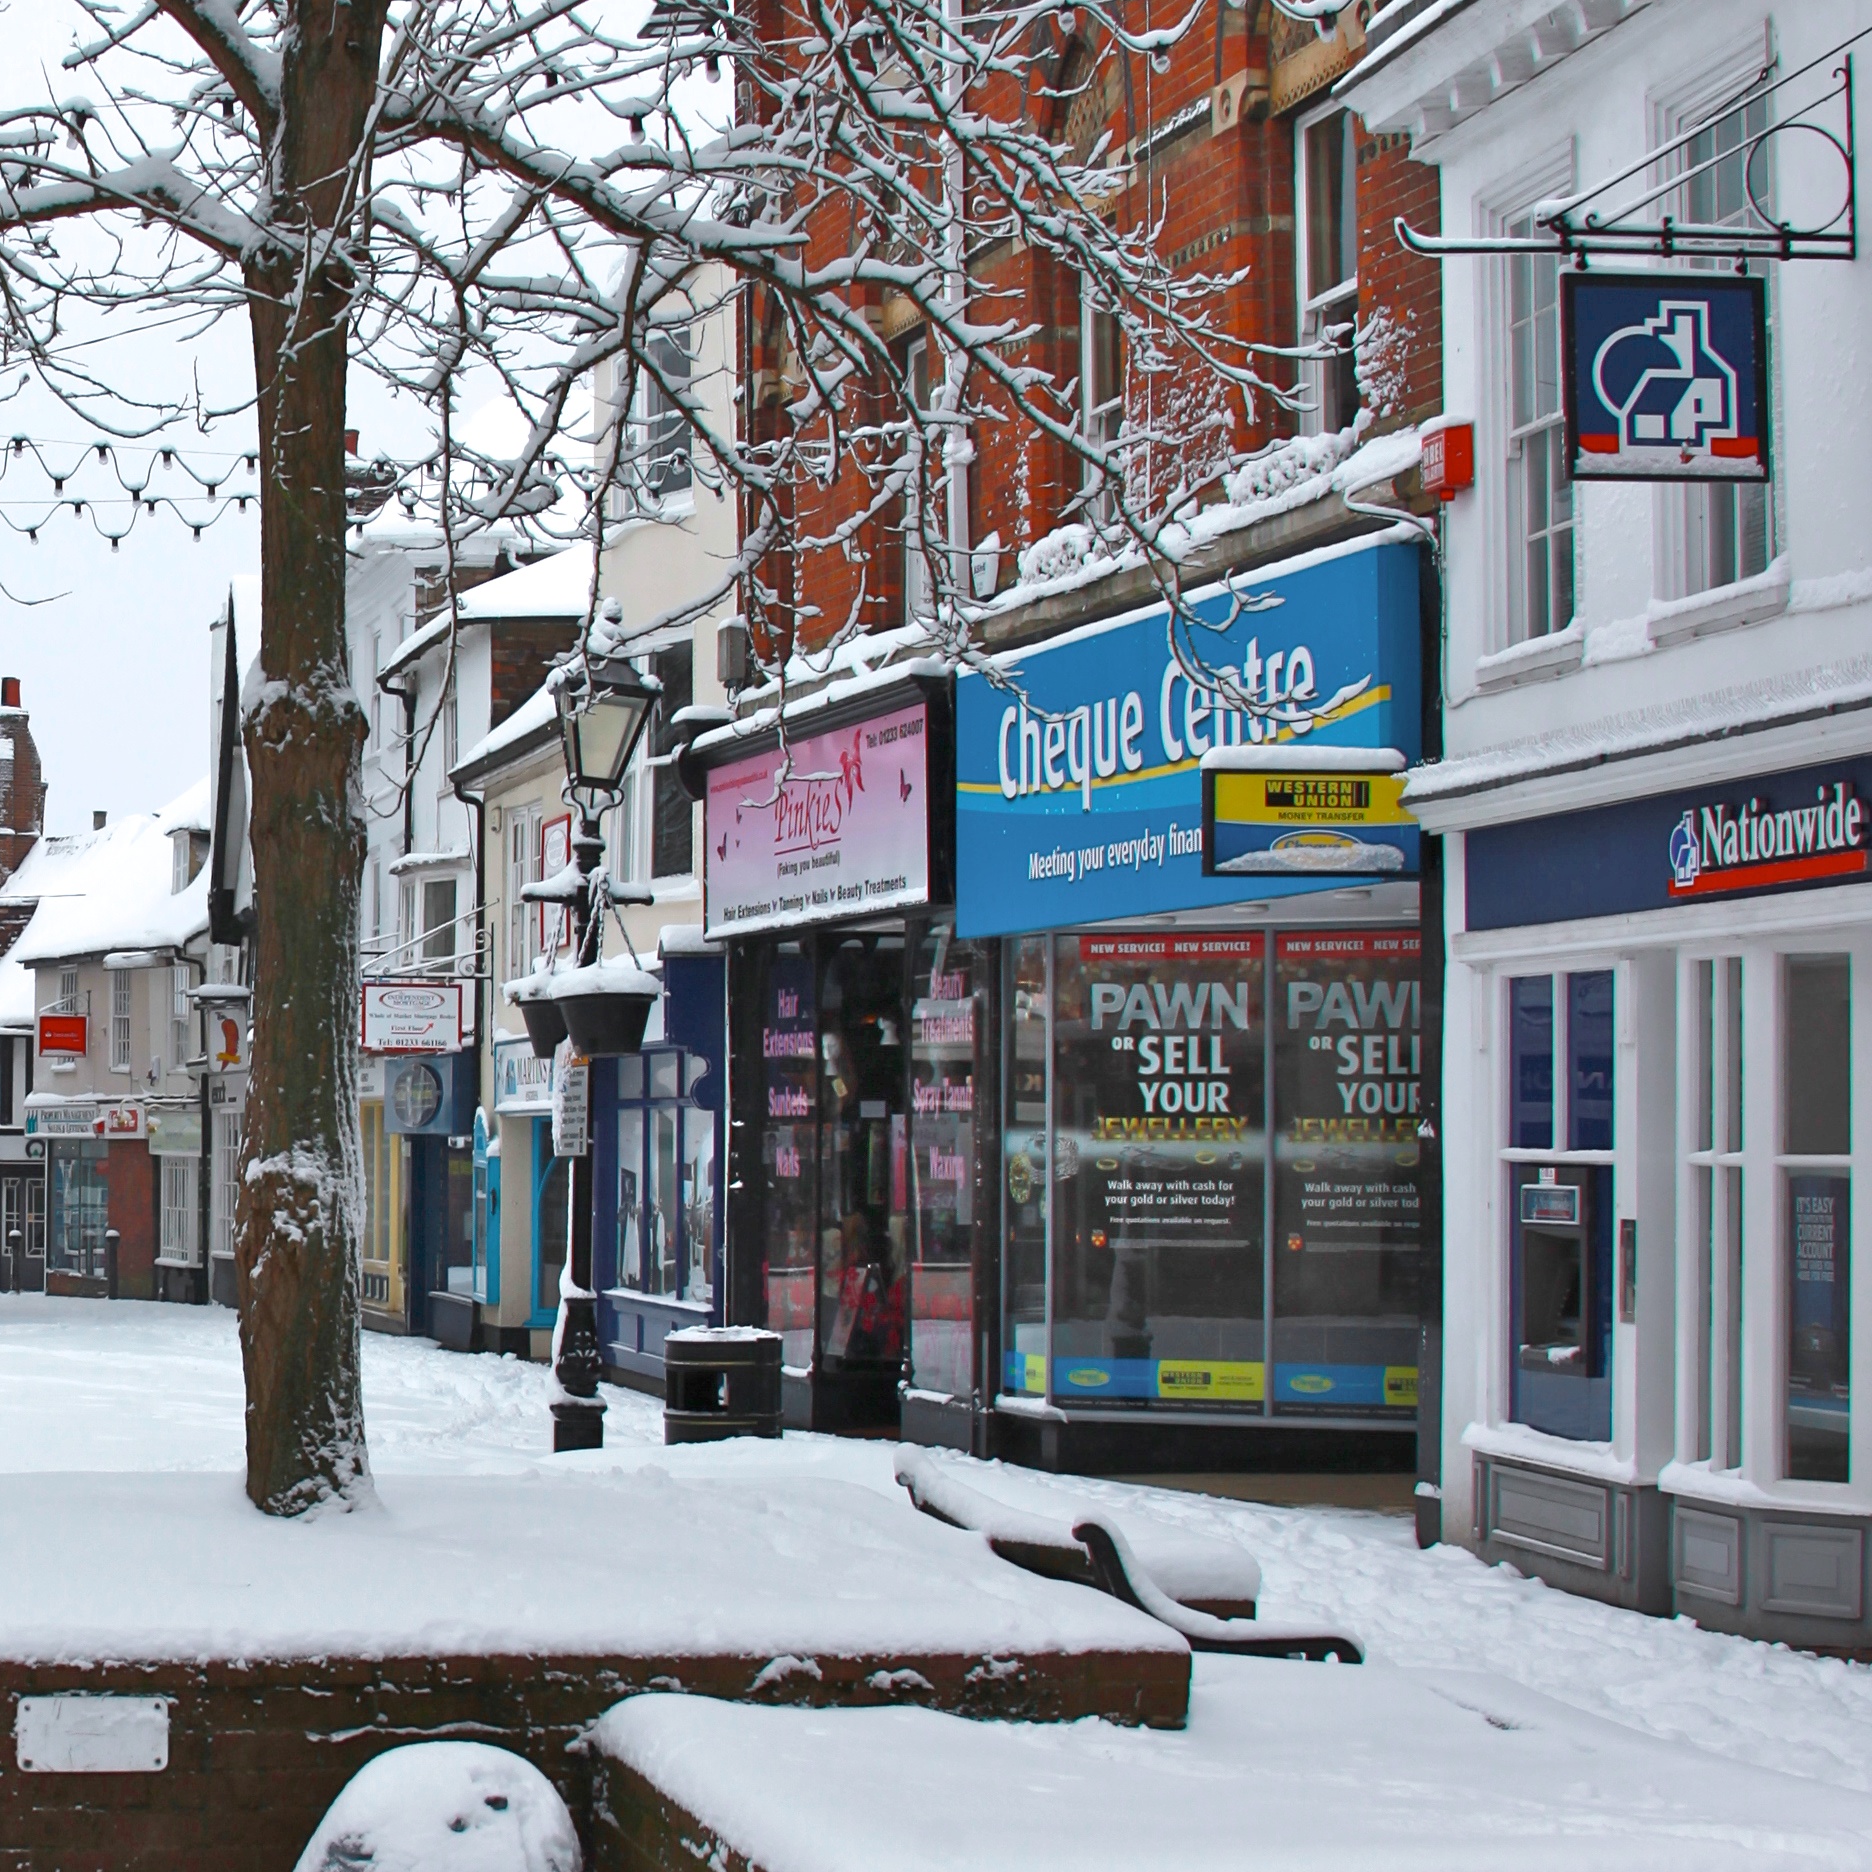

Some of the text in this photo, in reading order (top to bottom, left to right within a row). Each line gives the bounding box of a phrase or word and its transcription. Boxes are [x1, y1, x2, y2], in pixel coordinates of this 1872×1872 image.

[998, 636, 1315, 812] Cheque Centre
[1266, 781, 1352, 794] WESTERN
[1294, 794, 1352, 807] UNION
[1278, 812, 1365, 821] MONEY TRANSFER
[1701, 782, 1862, 868] Nationwide
[799, 860, 810, 875] you
[1028, 845, 1076, 883] Meeting
[1078, 845, 1105, 880] your
[1107, 828, 1166, 871] everyday
[723, 875, 907, 921] Hair Extensions Tanning Nails Beauty Treatments
[1091, 941, 1250, 954] NEW SERVICE! NEW SERVICE!
[1287, 941, 1311, 952] NEW
[1315, 940, 1364, 951] SERVICE!
[1374, 940, 1398, 950] NEW
[778, 988, 799, 1018] Hair
[1091, 982, 1249, 1030] PAWN
[1287, 981, 1420, 1029] PAW
[763, 1026, 815, 1057] Extensions
[1111, 1035, 1230, 1074] OR SELL
[1309, 1036, 1332, 1050] OR
[768, 1086, 809, 1116] Sunbeds
[1138, 1081, 1230, 1113] YOUR
[1091, 1116, 1249, 1142] JEWELLERY
[1289, 1117, 1420, 1142] JEWELLE
[776, 1146, 800, 1177] Nails
[1107, 1180, 1234, 1192] Walk away with cash for
[1304, 1182, 1416, 1195] Walk away with cash
[1105, 1194, 1236, 1207] your gold or silver today!
[1301, 1198, 1326, 1209] your
[1329, 1197, 1352, 1209] gold
[1356, 1198, 1367, 1207] or
[1370, 1197, 1398, 1208] silver
